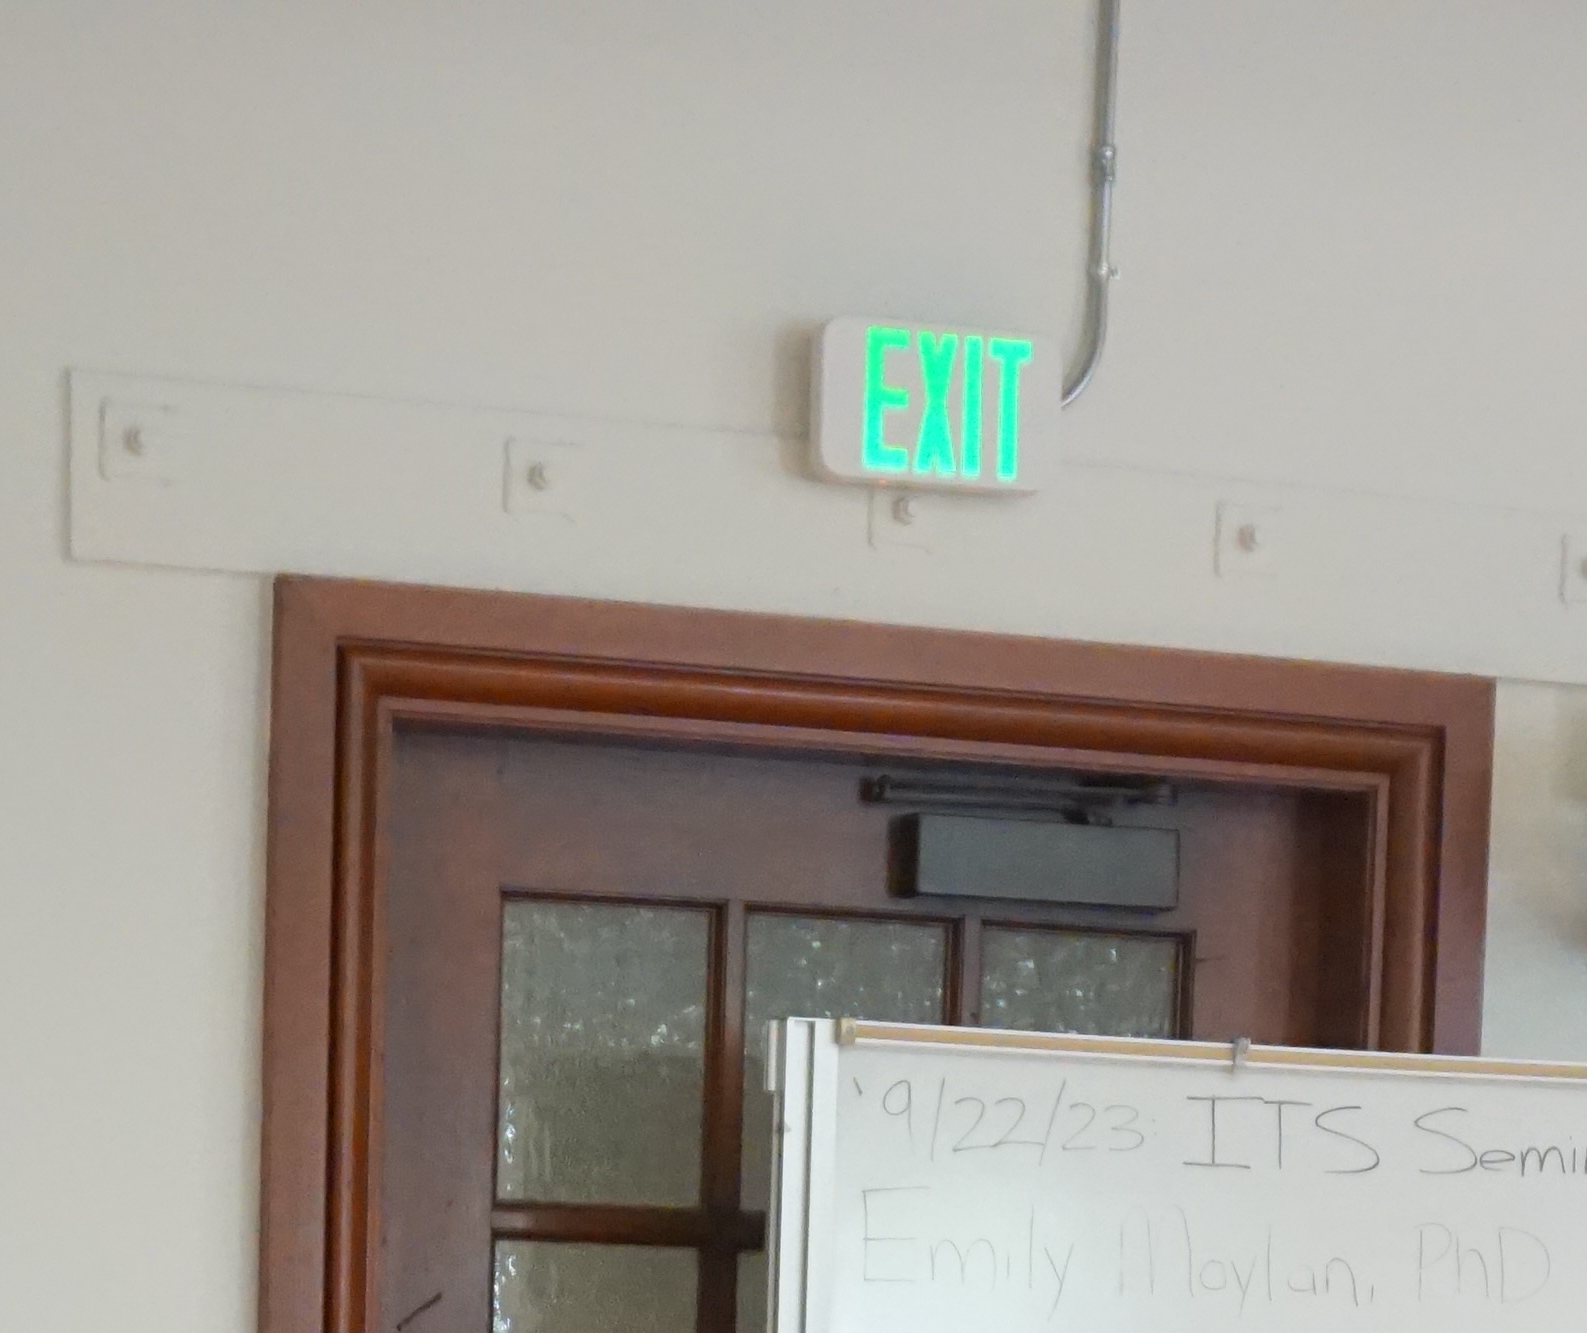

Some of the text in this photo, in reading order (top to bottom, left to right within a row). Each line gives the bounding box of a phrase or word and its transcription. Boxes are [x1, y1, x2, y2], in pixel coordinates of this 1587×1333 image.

[863, 325, 1034, 481] EXIT
[1183, 1093, 1380, 1175] ITS
[862, 1185, 1075, 1321] Emily
[1412, 1222, 1551, 1304] PhD
